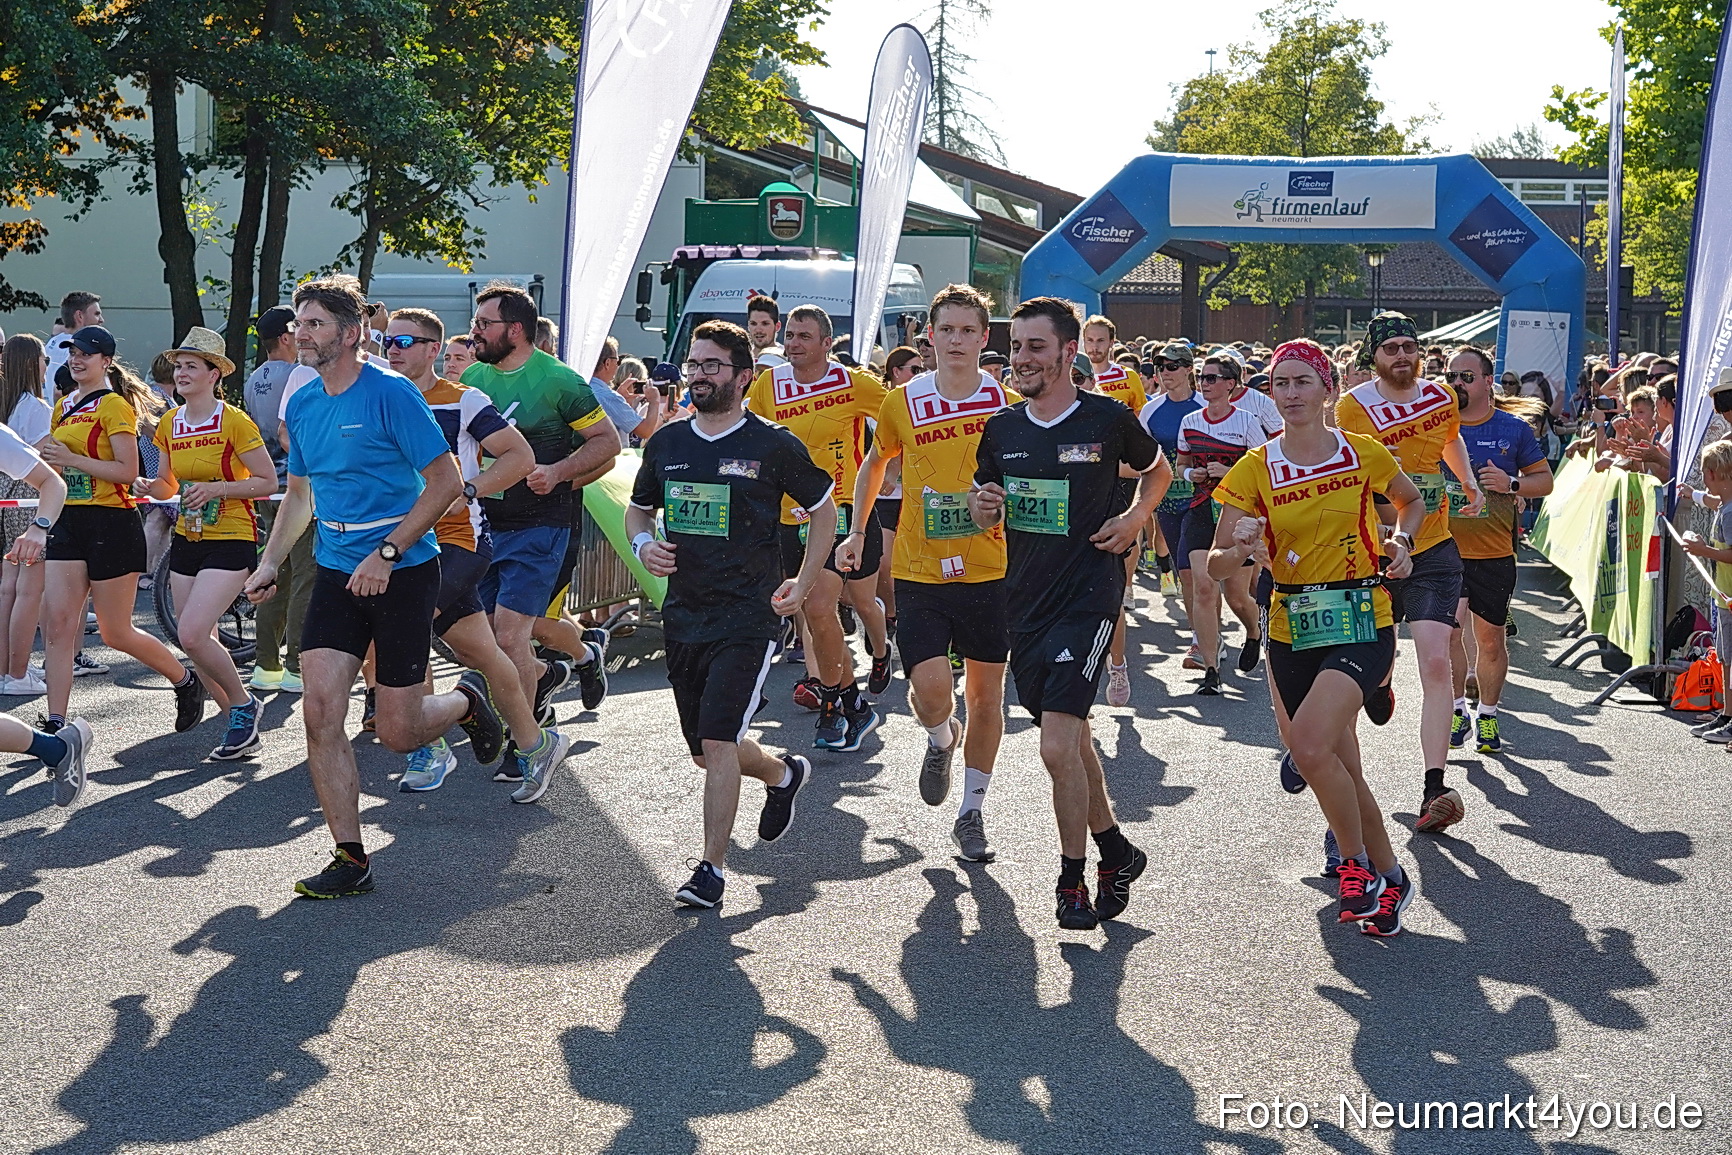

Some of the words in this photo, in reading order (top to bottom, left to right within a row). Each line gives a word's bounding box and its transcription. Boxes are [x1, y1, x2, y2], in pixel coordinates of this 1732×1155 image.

[1298, 178, 1331, 188] Fischer
[1271, 197, 1371, 216] firmenlauf
[1081, 223, 1135, 238] Fischer
[1466, 231, 1481, 241] und
[1481, 229, 1496, 238] das
[1085, 236, 1130, 244] AUTOMOBILE
[699, 288, 745, 299] abavent
[775, 403, 809, 421] MAX
[814, 392, 854, 411] BÖGL
[70, 414, 95, 425] BÖGL
[914, 424, 959, 447] MAX
[962, 417, 987, 436] BÖ
[1381, 425, 1418, 447] MAX
[171, 440, 193, 452] MAX
[195, 436, 225, 449] BÖGL
[1002, 452, 1024, 460] CRAFT
[664, 463, 684, 472] CRAFT
[1272, 487, 1313, 507] MAX
[1315, 475, 1363, 496] BÖGL
[1017, 497, 1047, 515] 421
[1451, 494, 1472, 506] 64
[679, 500, 710, 518] 471
[941, 508, 972, 524] 813
[1039, 516, 1053, 524] Max
[1362, 577, 1381, 586] 2XU
[1303, 584, 1328, 592] 2XU
[1300, 609, 1334, 630] 816
[1342, 611, 1350, 636] 2022
[1054, 655, 1075, 663] adidas
[1348, 661, 1363, 672] JAKO
